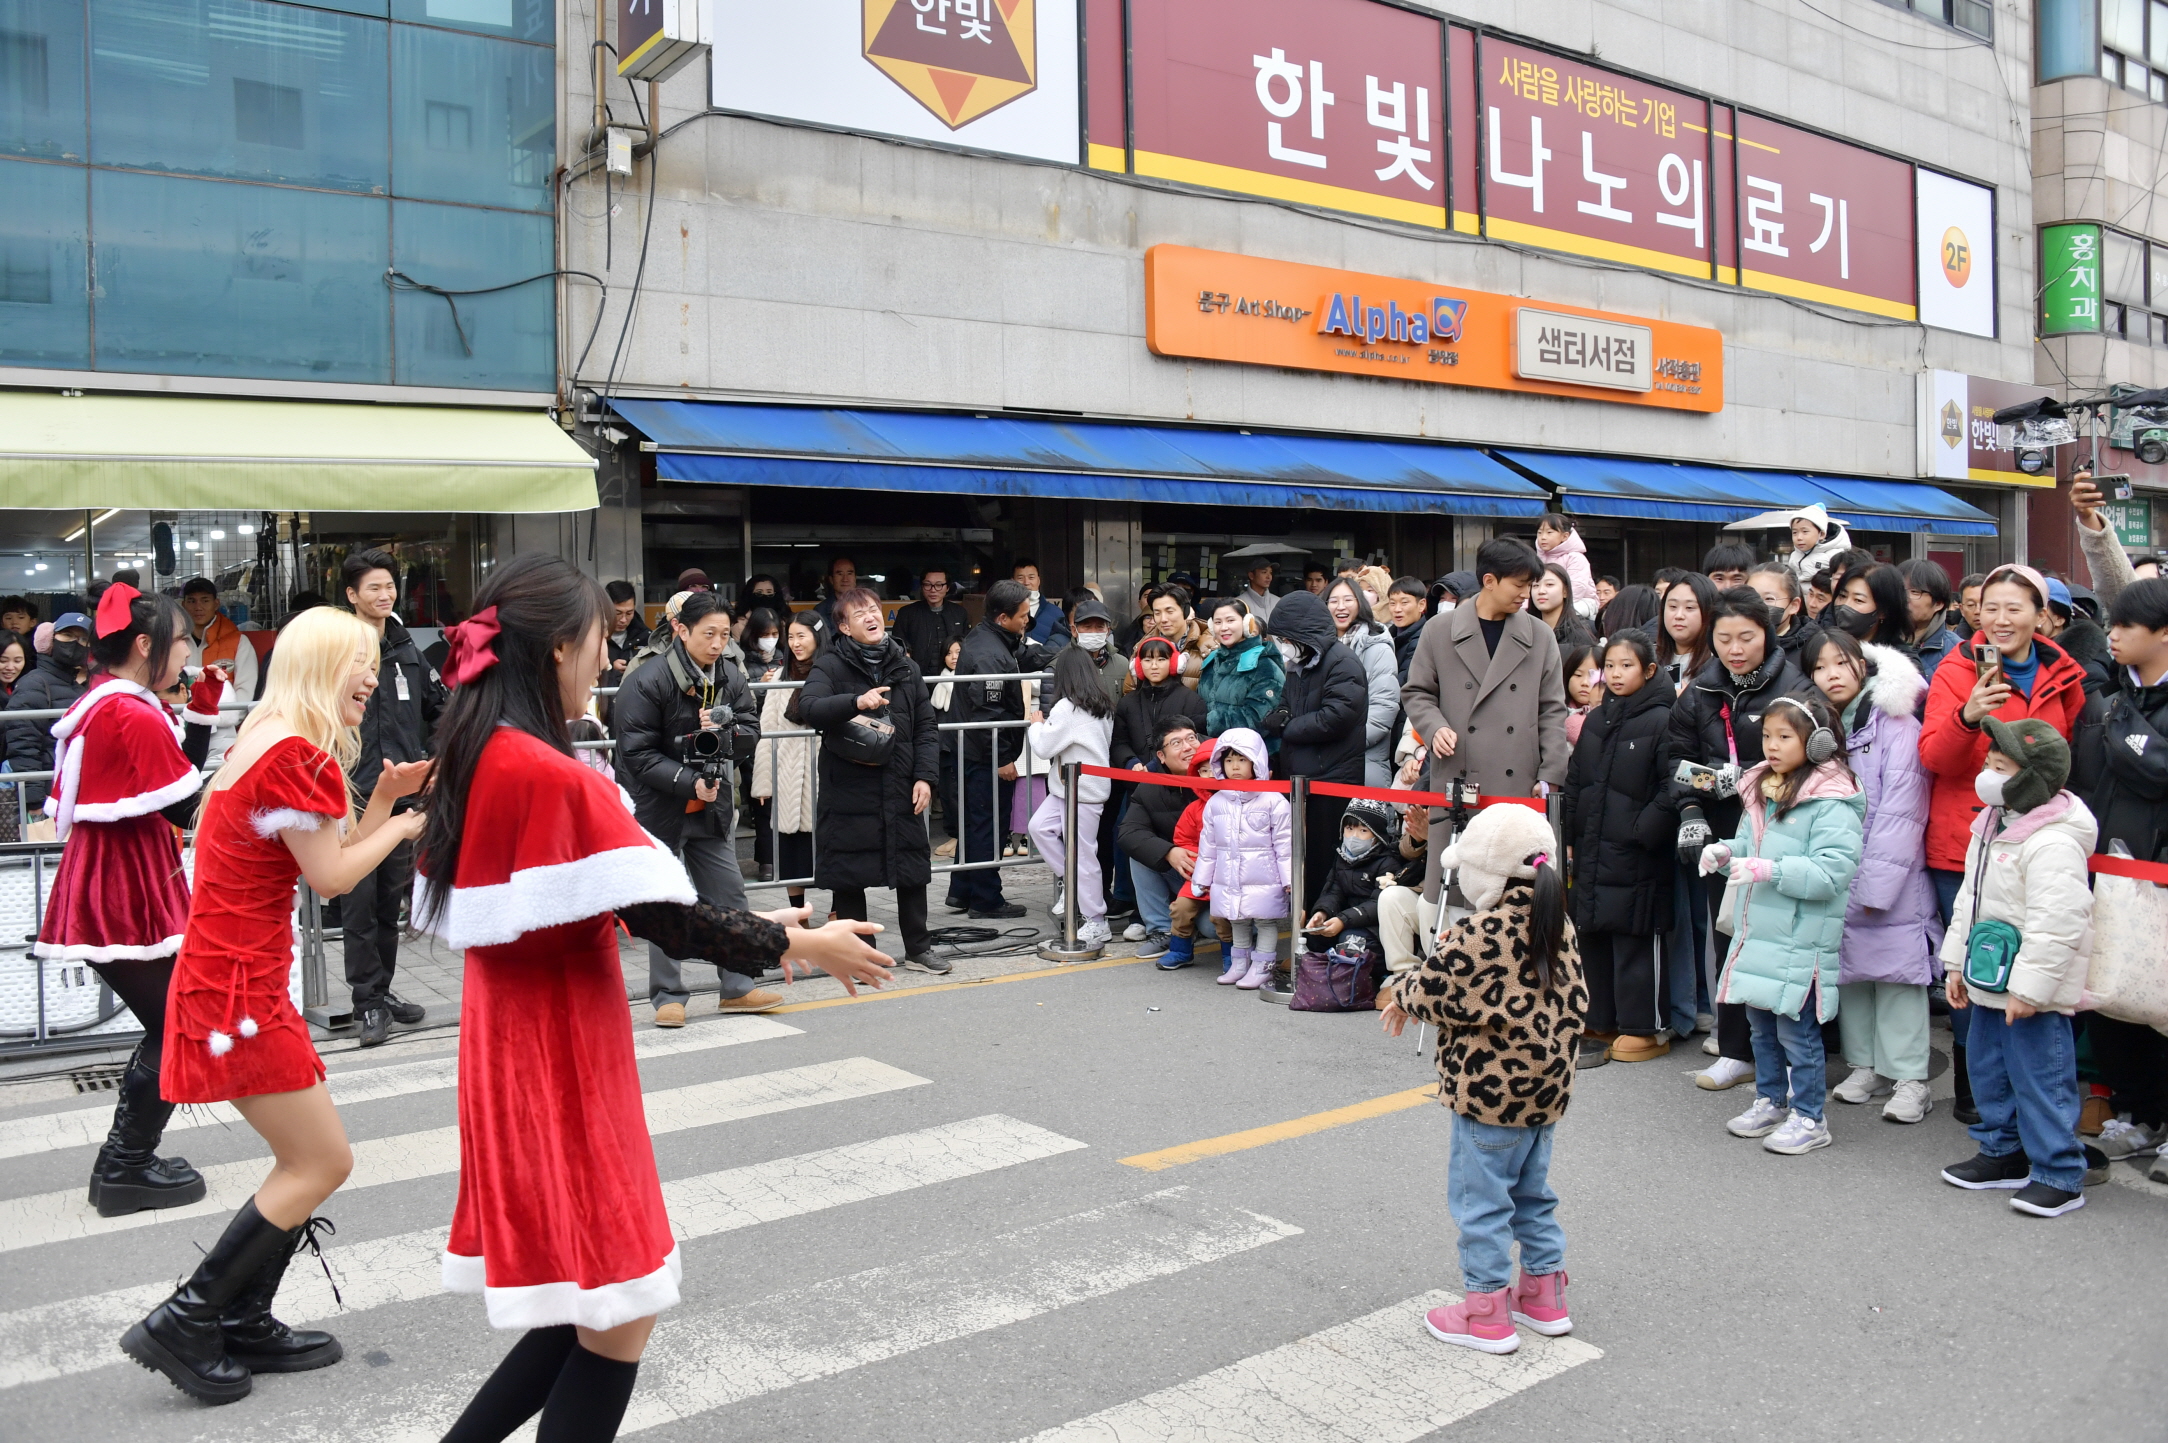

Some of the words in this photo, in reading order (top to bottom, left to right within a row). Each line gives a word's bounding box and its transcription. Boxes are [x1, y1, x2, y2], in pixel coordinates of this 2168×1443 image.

[1499, 56, 1560, 107] 사람을
[1564, 75, 1638, 128] 사랑하는
[1642, 97, 1676, 139] 기업
[1945, 241, 1968, 272] 2F
[1198, 290, 1232, 314] 문구
[1235, 296, 1261, 316] Art
[1323, 292, 1430, 345] Alpha
[1335, 348, 1411, 365] www.alpha.co.kr
[1537, 326, 1636, 375] 샘터서점
[1946, 417, 1958, 430] 한빛
